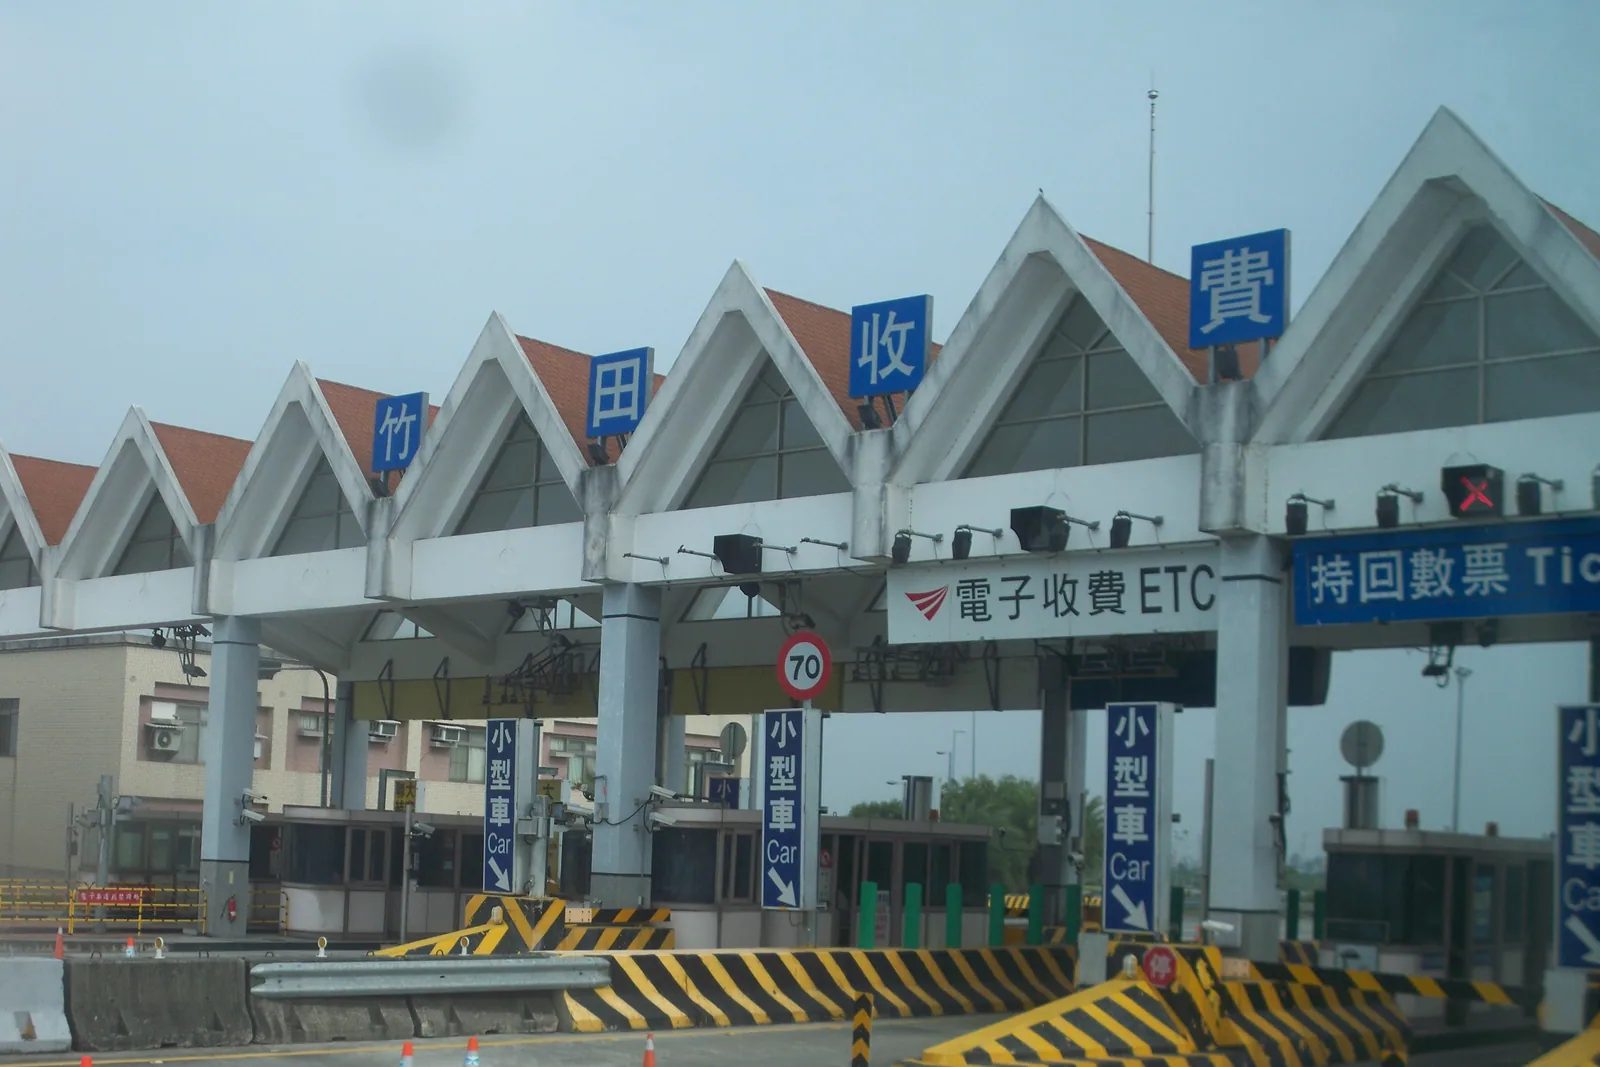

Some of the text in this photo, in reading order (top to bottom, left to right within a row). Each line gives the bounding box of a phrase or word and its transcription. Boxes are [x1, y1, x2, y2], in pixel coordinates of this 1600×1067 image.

[1200, 247, 1274, 334] 費
[857, 310, 916, 386] 收
[592, 356, 641, 429] 田
[379, 402, 417, 462] 竹
[956, 563, 1216, 623] 電子收費 ETC
[1311, 543, 1510, 605] 持回數票
[789, 654, 821, 681] 70
[489, 722, 512, 827] 小型車
[768, 712, 797, 833] 小型車
[1113, 706, 1150, 845] 小型車
[488, 832, 511, 854] Car
[767, 839, 798, 864] Car
[1110, 852, 1150, 882] Car
